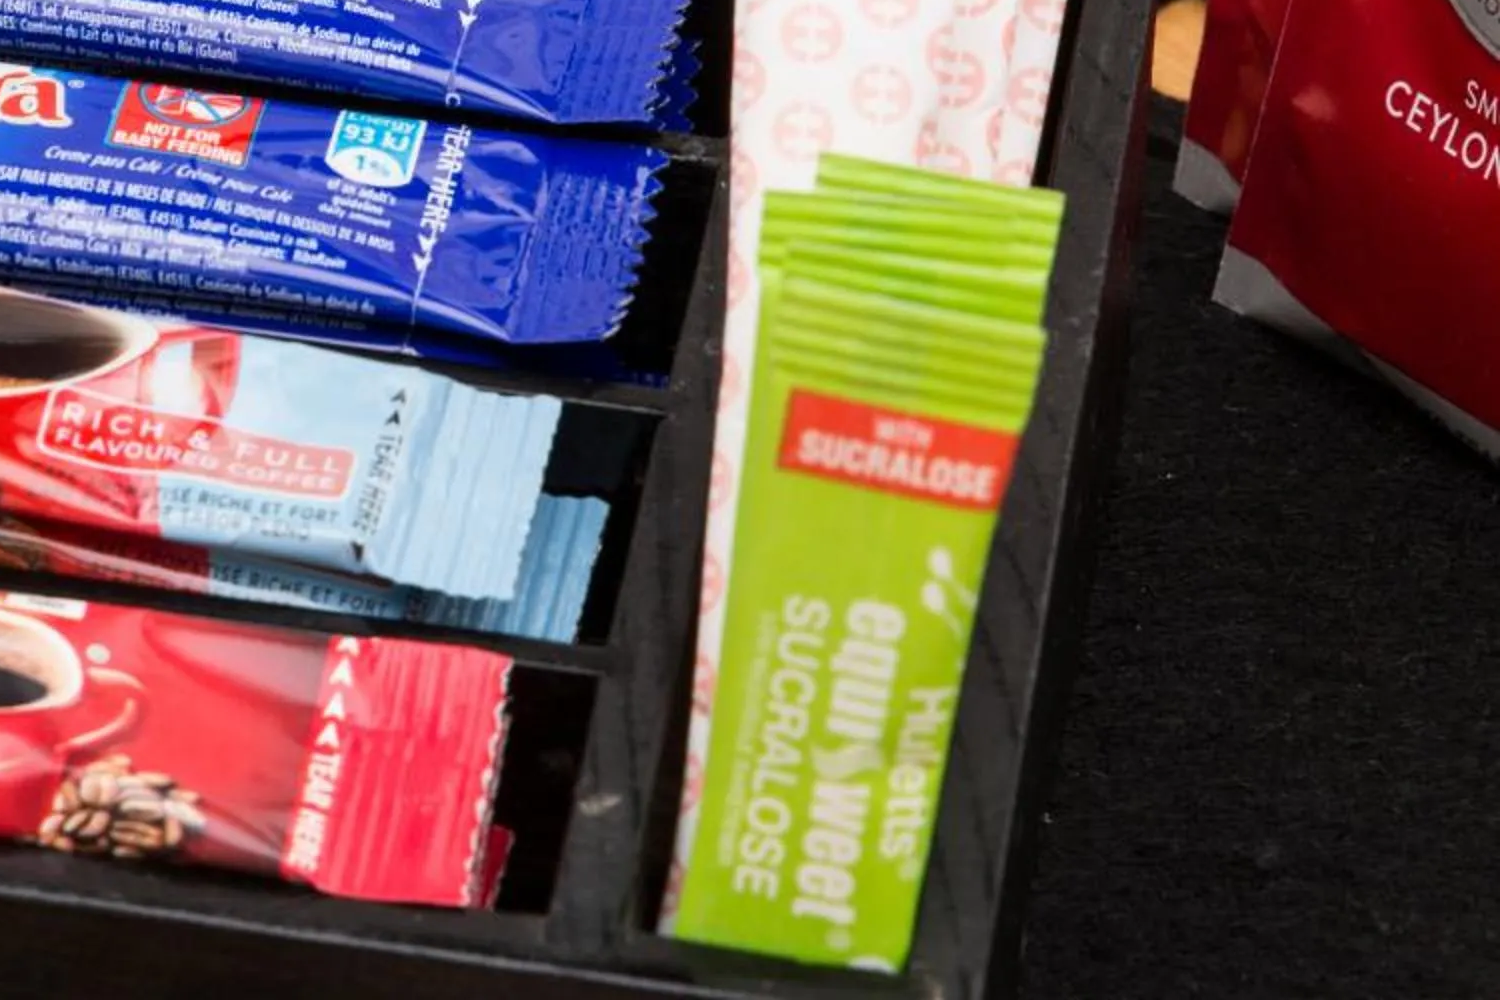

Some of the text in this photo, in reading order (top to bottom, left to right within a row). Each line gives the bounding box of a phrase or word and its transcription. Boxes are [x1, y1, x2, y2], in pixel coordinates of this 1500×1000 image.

[111, 129, 244, 166] BABY FEEDING
[143, 120, 222, 145] NOT FOR
[344, 123, 377, 145] 93
[419, 124, 469, 234] TEAR HERE
[55, 428, 219, 470] FLAVOURED
[226, 462, 338, 490] COFFEE
[61, 401, 341, 474] RICH & FULL
[797, 427, 999, 504] SUCRALOSE
[198, 490, 251, 512] RICHE
[260, 499, 284, 516] ET
[289, 502, 341, 524] FORT
[731, 593, 832, 901] SUCRALOSE
